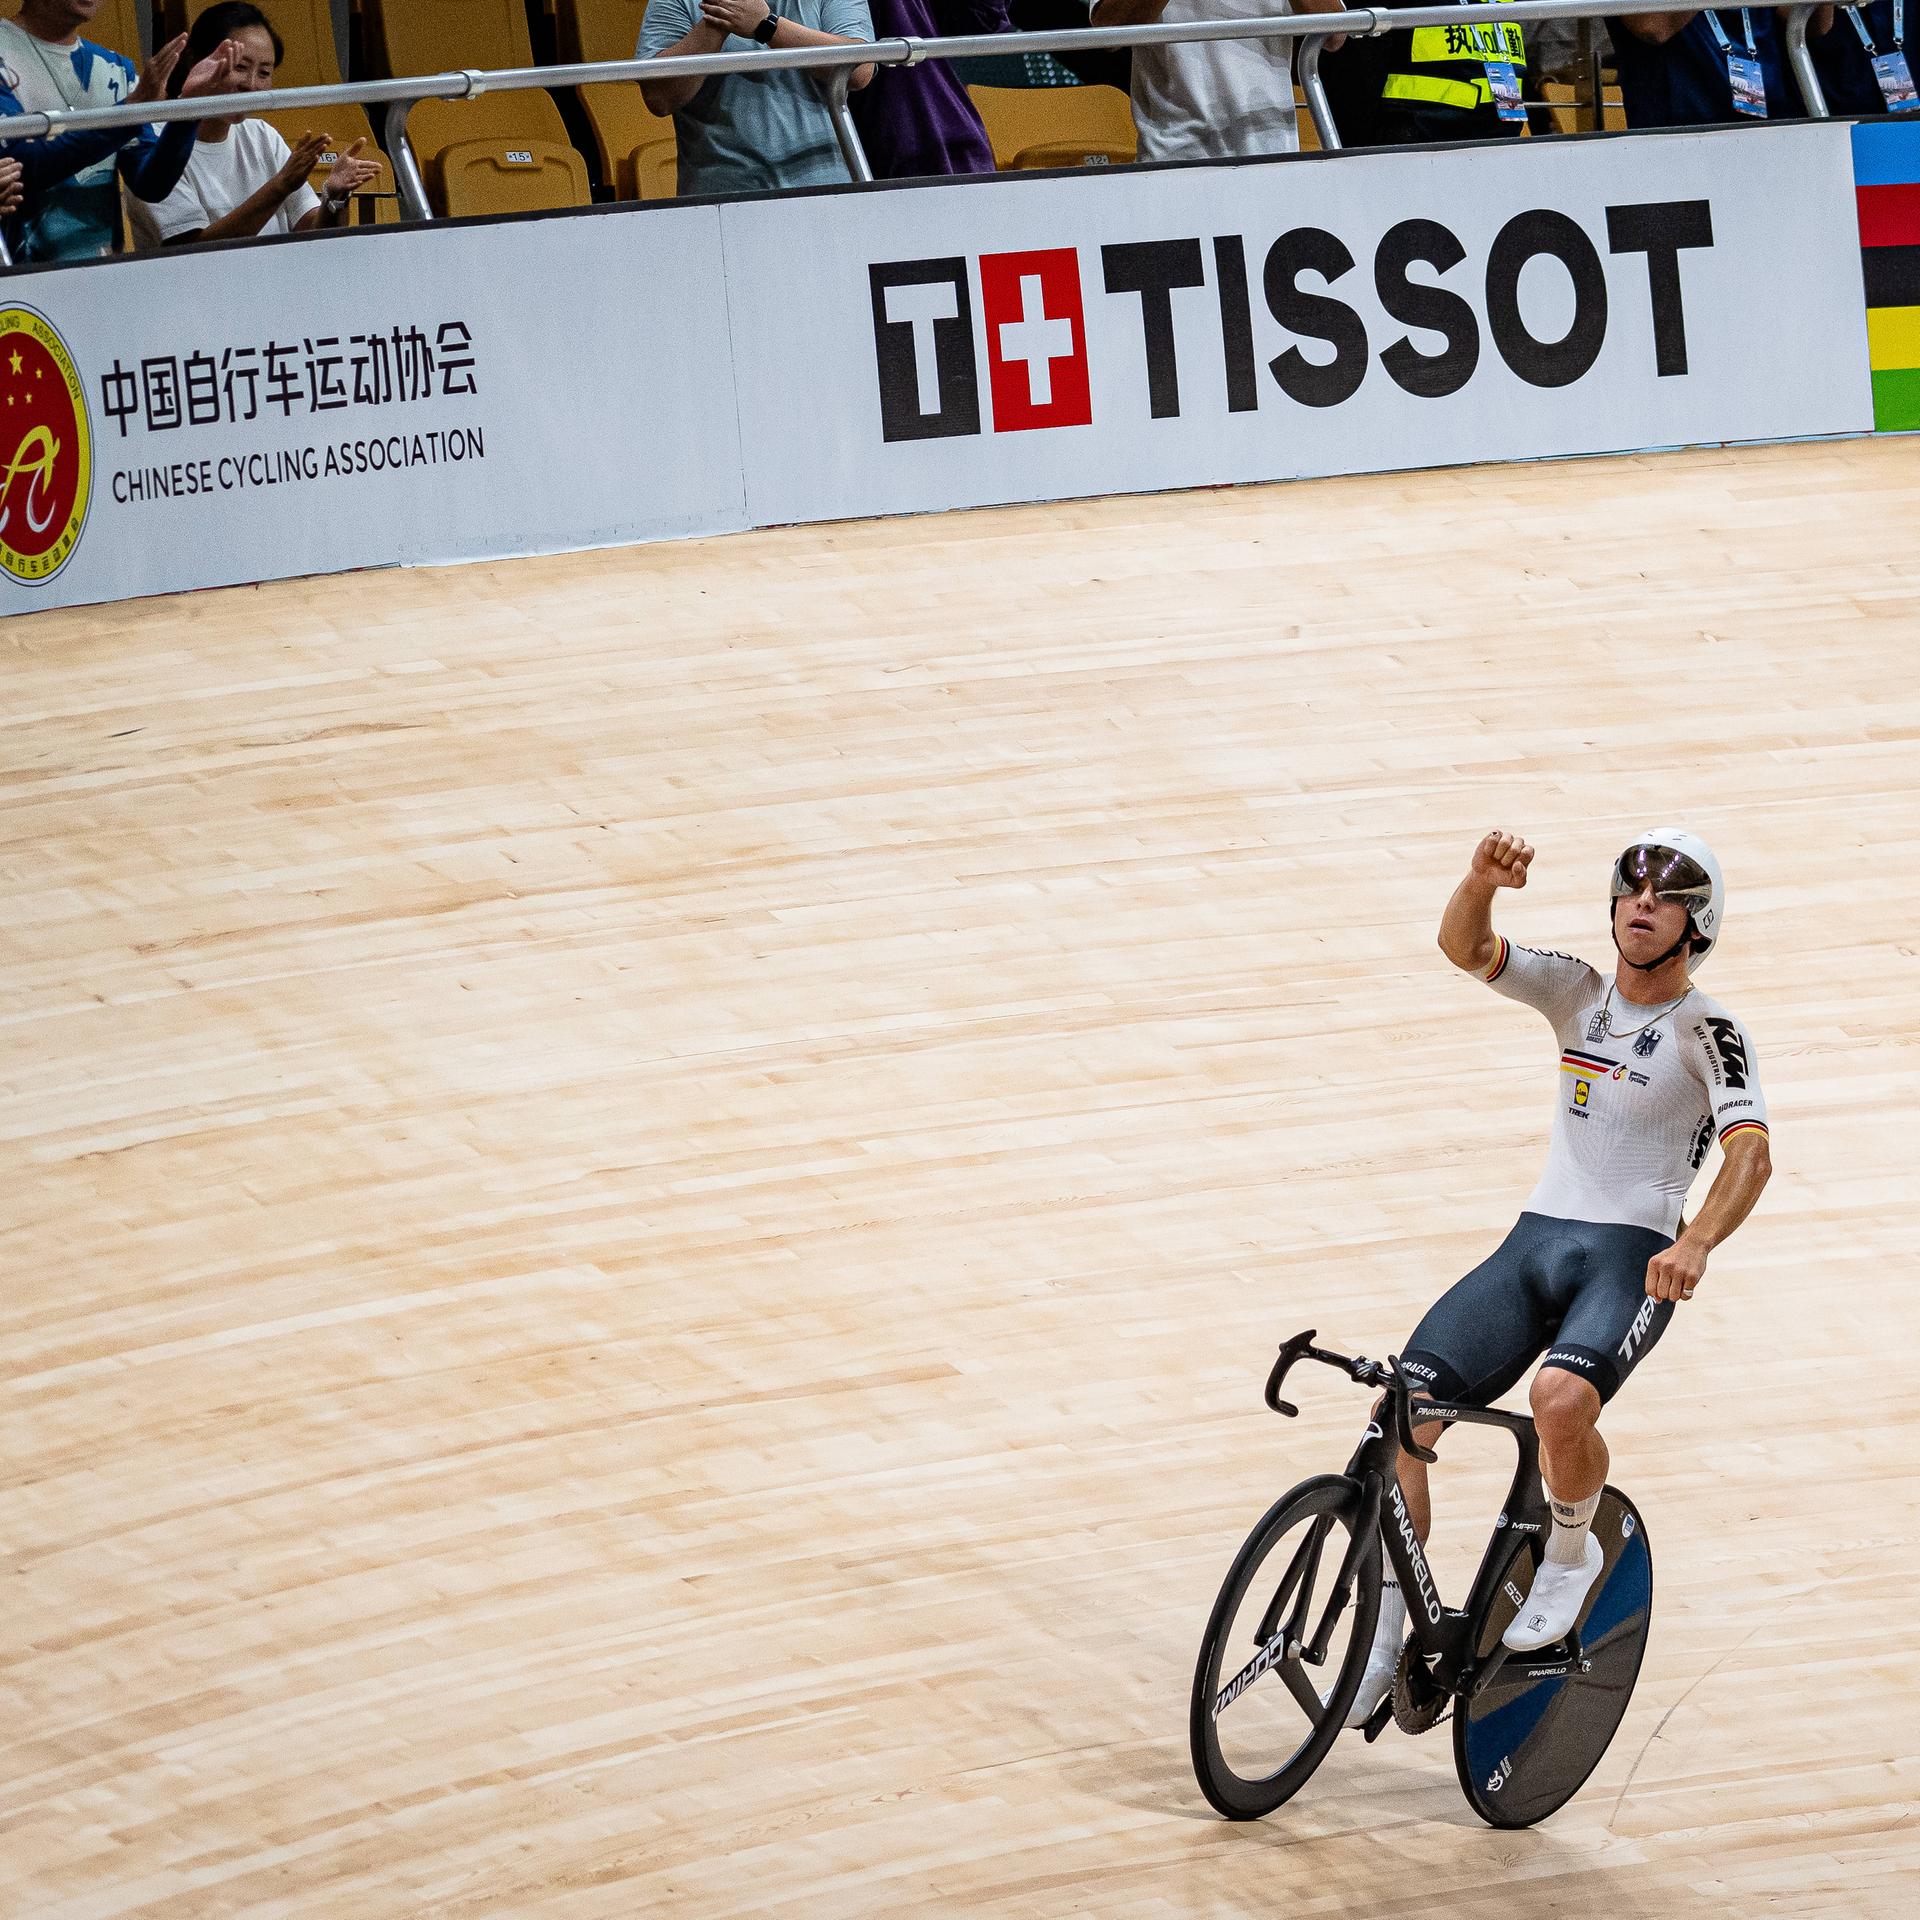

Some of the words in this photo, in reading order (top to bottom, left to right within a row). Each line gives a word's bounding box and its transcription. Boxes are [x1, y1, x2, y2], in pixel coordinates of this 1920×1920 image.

[512, 152, 526, 161] 15
[1101, 199, 1715, 420] TISSOT
[101, 321, 478, 437] 中国自行车运动协会
[112, 460, 214, 504] CHINESE
[217, 447, 318, 490] CYCLING
[324, 426, 485, 477] ASSOCIATION
[1693, 1025, 1707, 1041] BIKE
[1703, 1041, 1721, 1086] INDUSTRIES
[1704, 1017, 1749, 1090] KTM
[1568, 1107, 1590, 1120] TREK
[1717, 1099, 1753, 1114] BIORACER
[1691, 1114, 1717, 1169] KTM
[1416, 1407, 1458, 1417] PINARELLO
[1388, 1482, 1441, 1625] PINARELLO
[1527, 1667, 1567, 1678] PINARELLO
